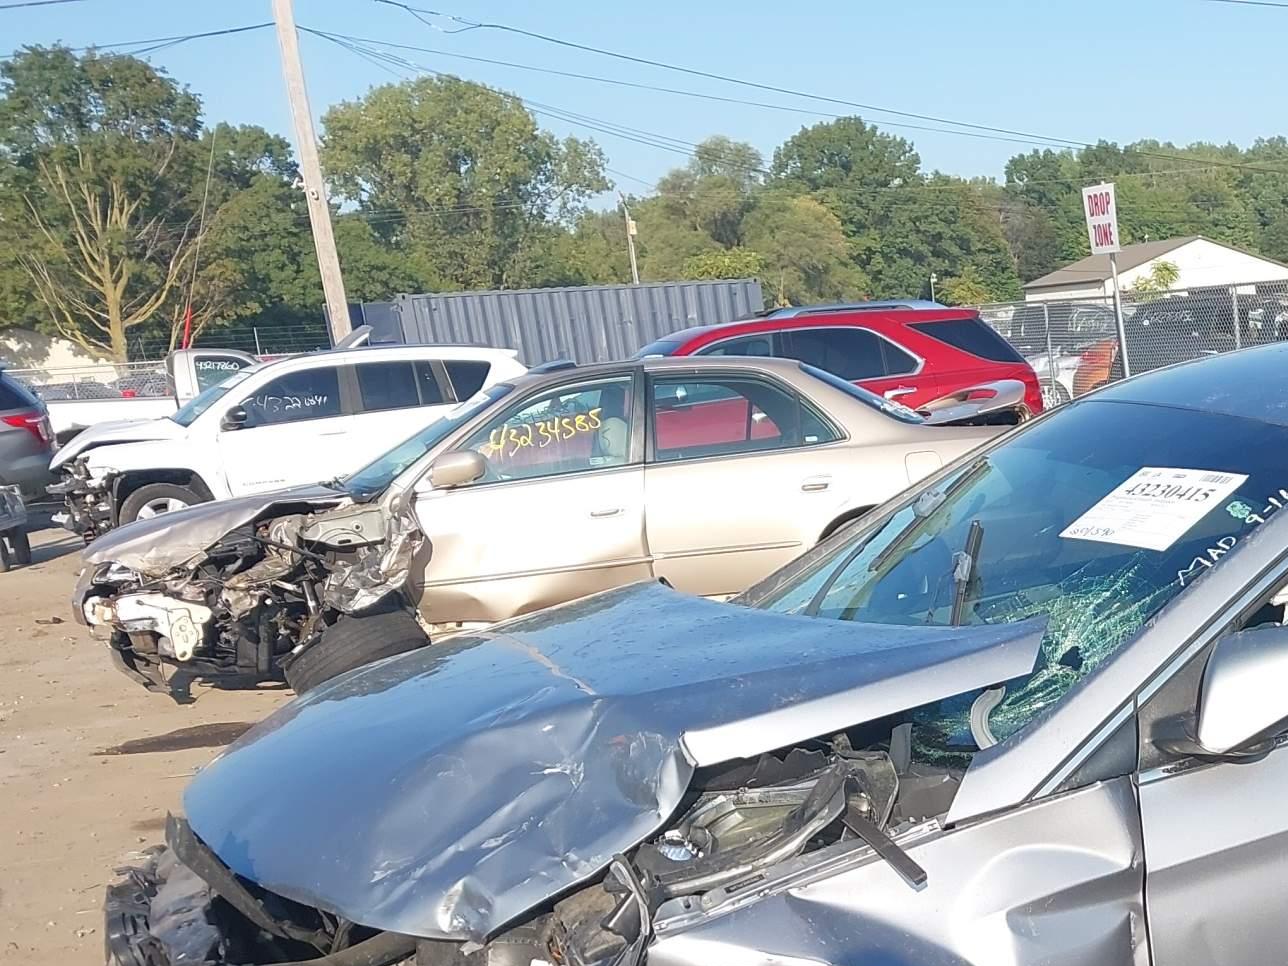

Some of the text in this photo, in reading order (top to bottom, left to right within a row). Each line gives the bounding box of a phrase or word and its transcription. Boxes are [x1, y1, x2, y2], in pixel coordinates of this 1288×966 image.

[1087, 191, 1111, 218] DROP
[1093, 223, 1114, 248] ZONE
[489, 407, 602, 458] 43234585
[1124, 482, 1217, 502] 43230415
[1177, 535, 1237, 587] MAD
